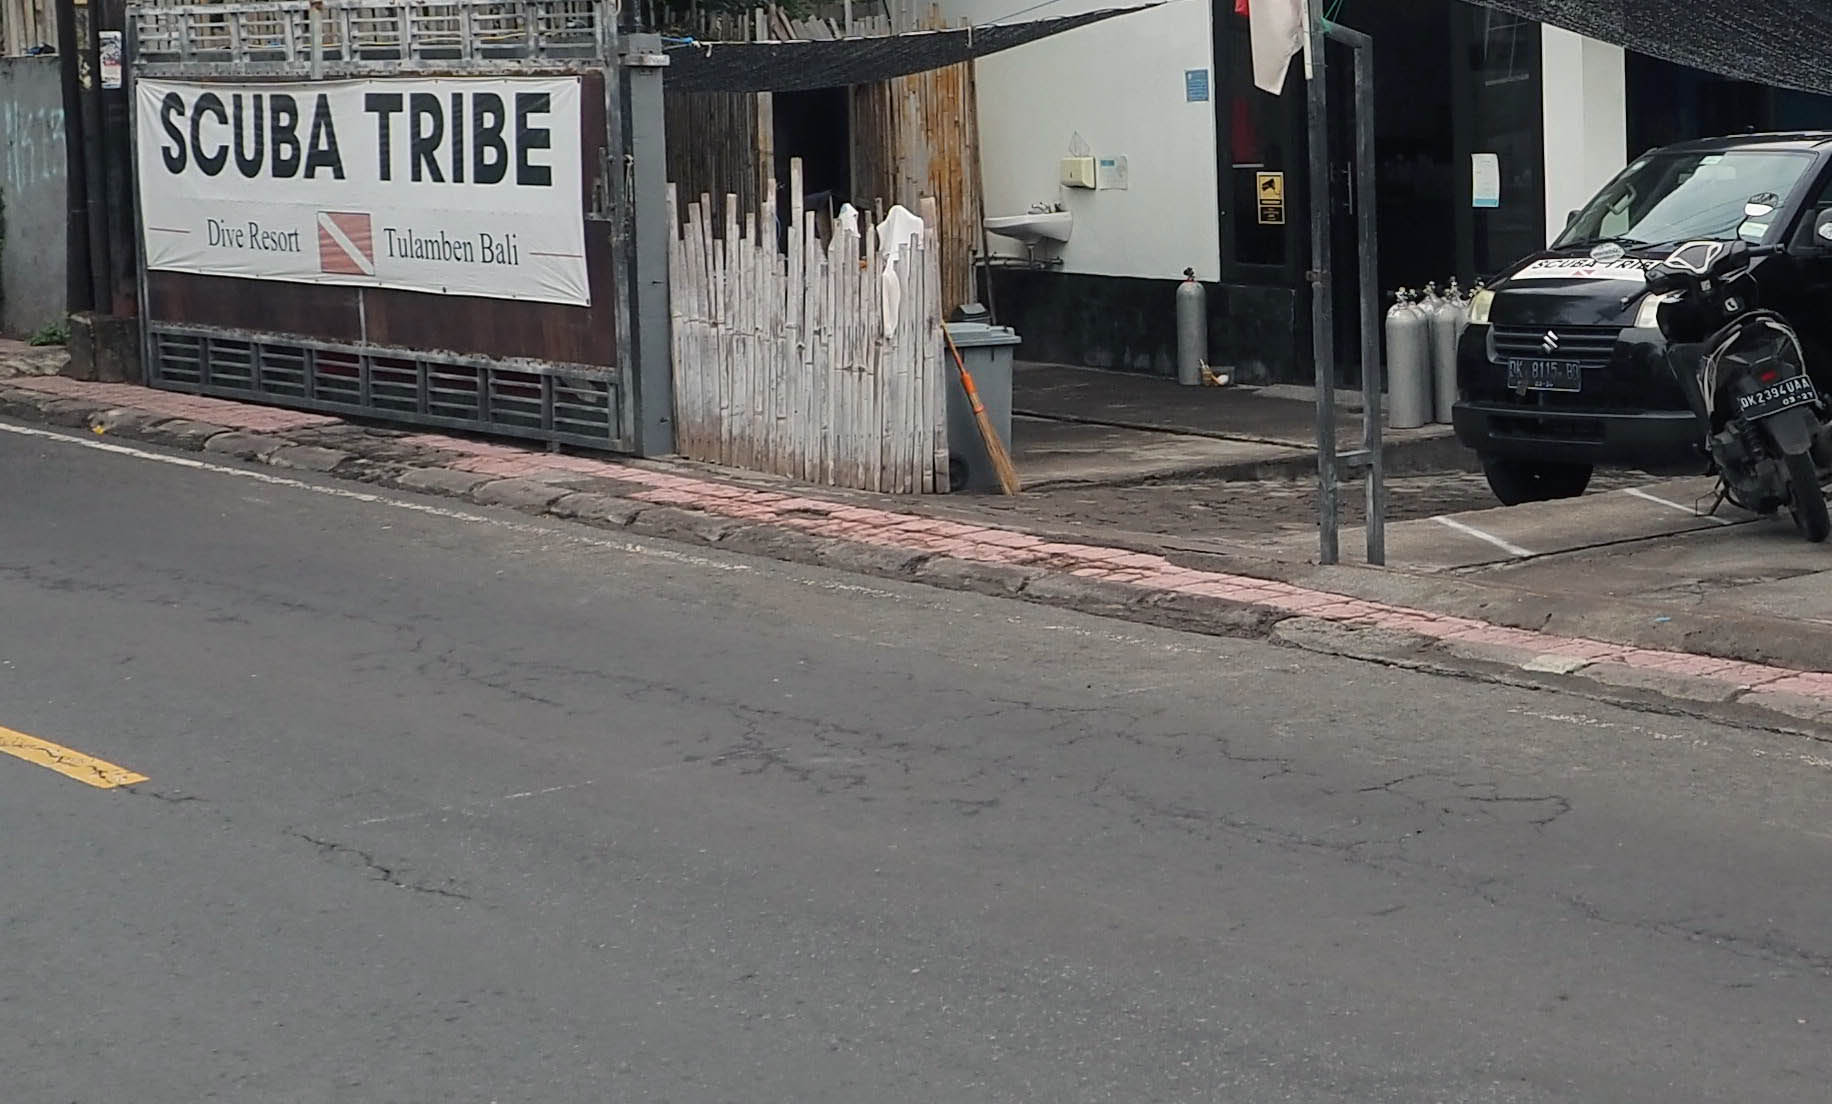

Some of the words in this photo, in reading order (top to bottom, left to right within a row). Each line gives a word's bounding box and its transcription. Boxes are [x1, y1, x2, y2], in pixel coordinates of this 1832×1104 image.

[160, 91, 347, 180] SCUBA
[364, 92, 553, 188] TRIBE
[207, 218, 243, 249] Dive
[249, 221, 302, 253] Resort
[384, 227, 476, 264] Tulamben
[480, 232, 520, 266] Bali
